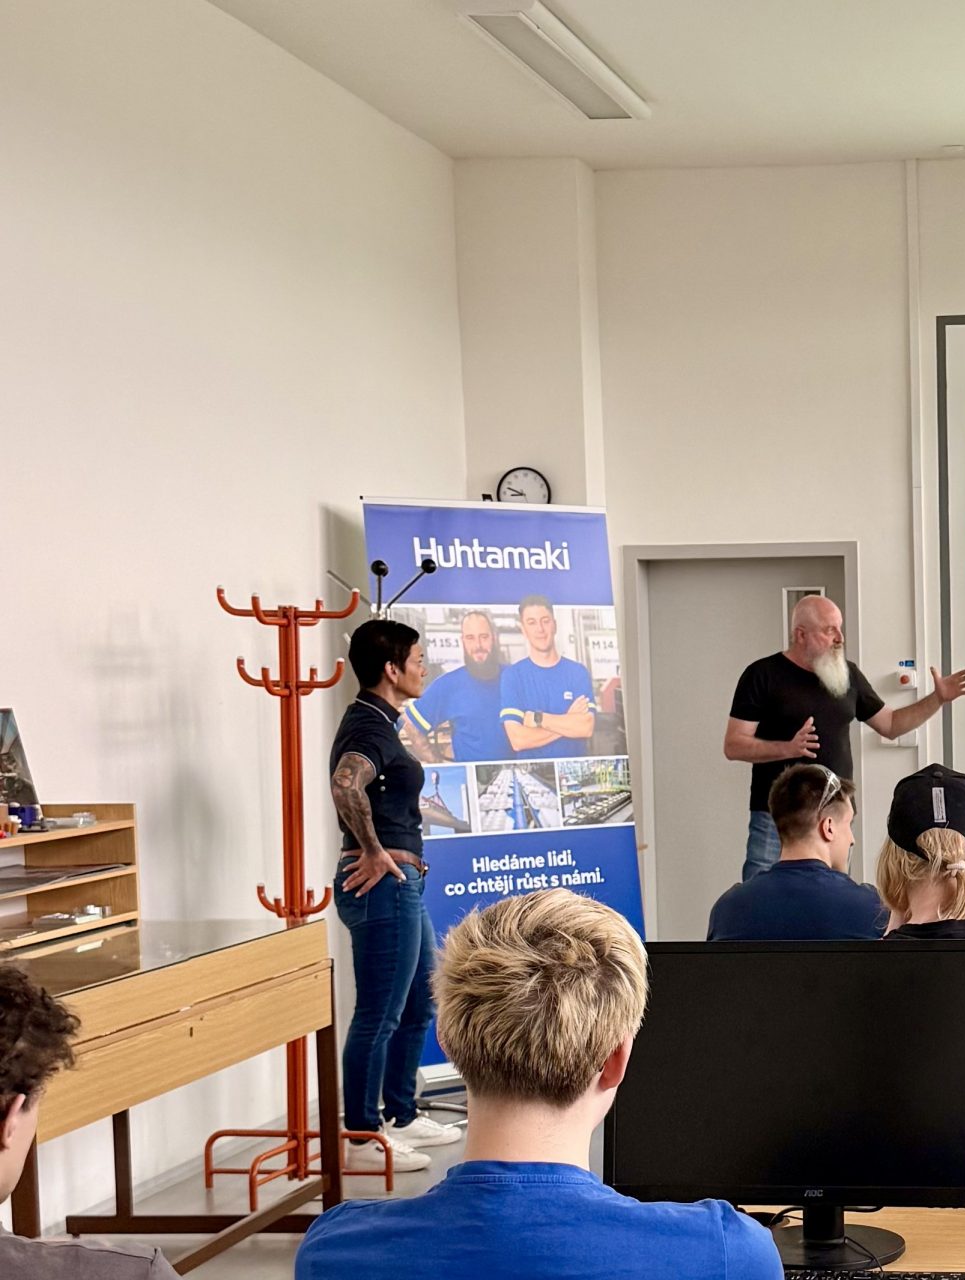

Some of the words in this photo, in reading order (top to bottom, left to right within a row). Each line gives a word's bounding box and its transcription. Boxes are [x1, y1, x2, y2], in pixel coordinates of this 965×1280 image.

[412, 536, 570, 570] Huhtamaki
[472, 853, 545, 874] Hledáme
[548, 850, 576, 867] lidi,
[445, 883, 465, 896] co
[467, 873, 514, 895] chtějí
[517, 871, 547, 889] růst
[550, 877, 558, 887] s
[562, 867, 605, 886] námi.
